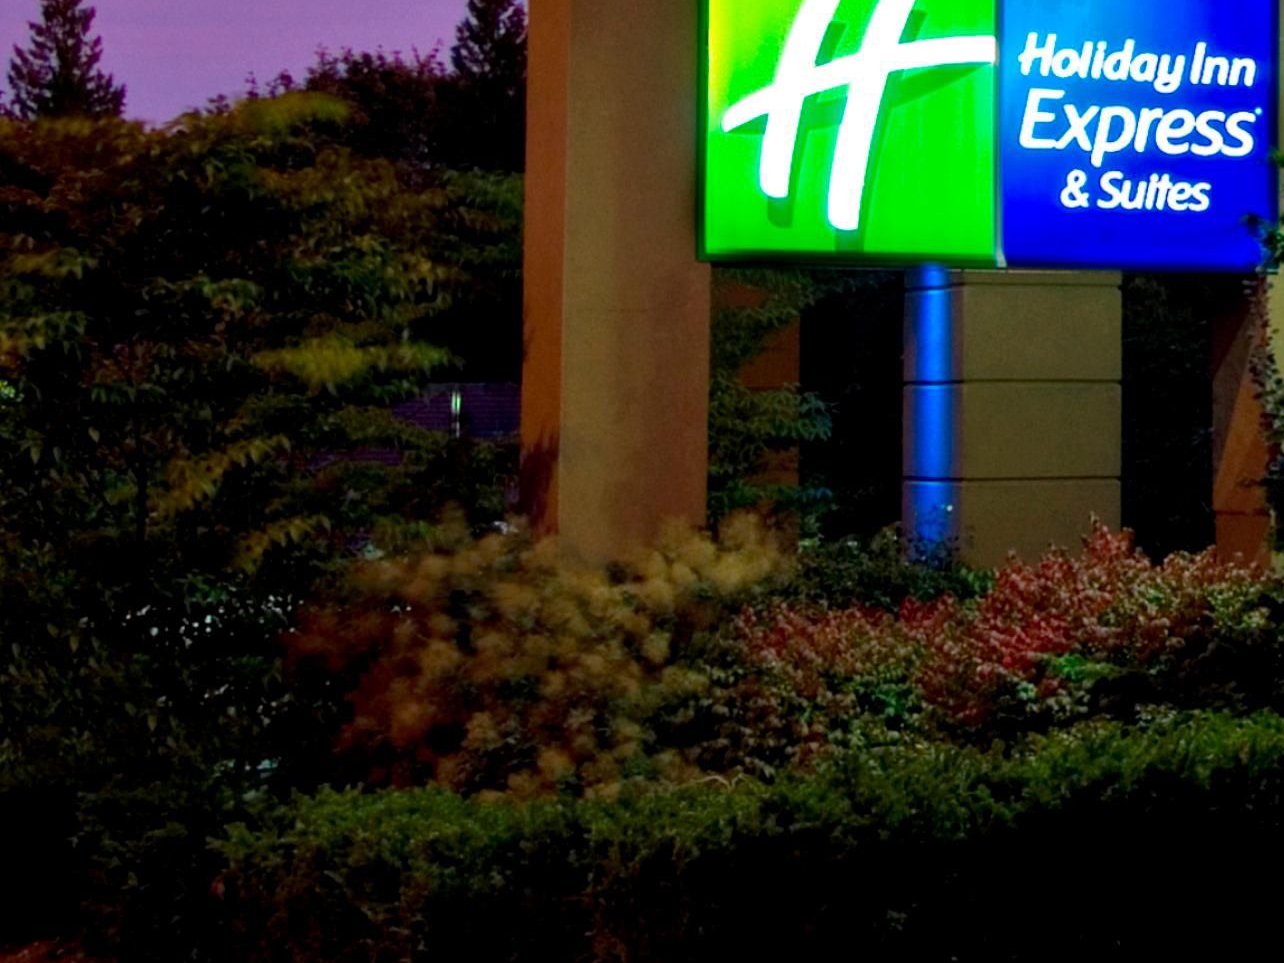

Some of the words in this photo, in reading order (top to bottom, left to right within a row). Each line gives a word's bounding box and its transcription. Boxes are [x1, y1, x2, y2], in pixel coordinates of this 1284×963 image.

[1018, 31, 1186, 93] Holiday
[1191, 41, 1256, 87] Inn
[1018, 88, 1256, 166] Express
[1060, 170, 1090, 210] &
[1097, 170, 1211, 212] Suites
